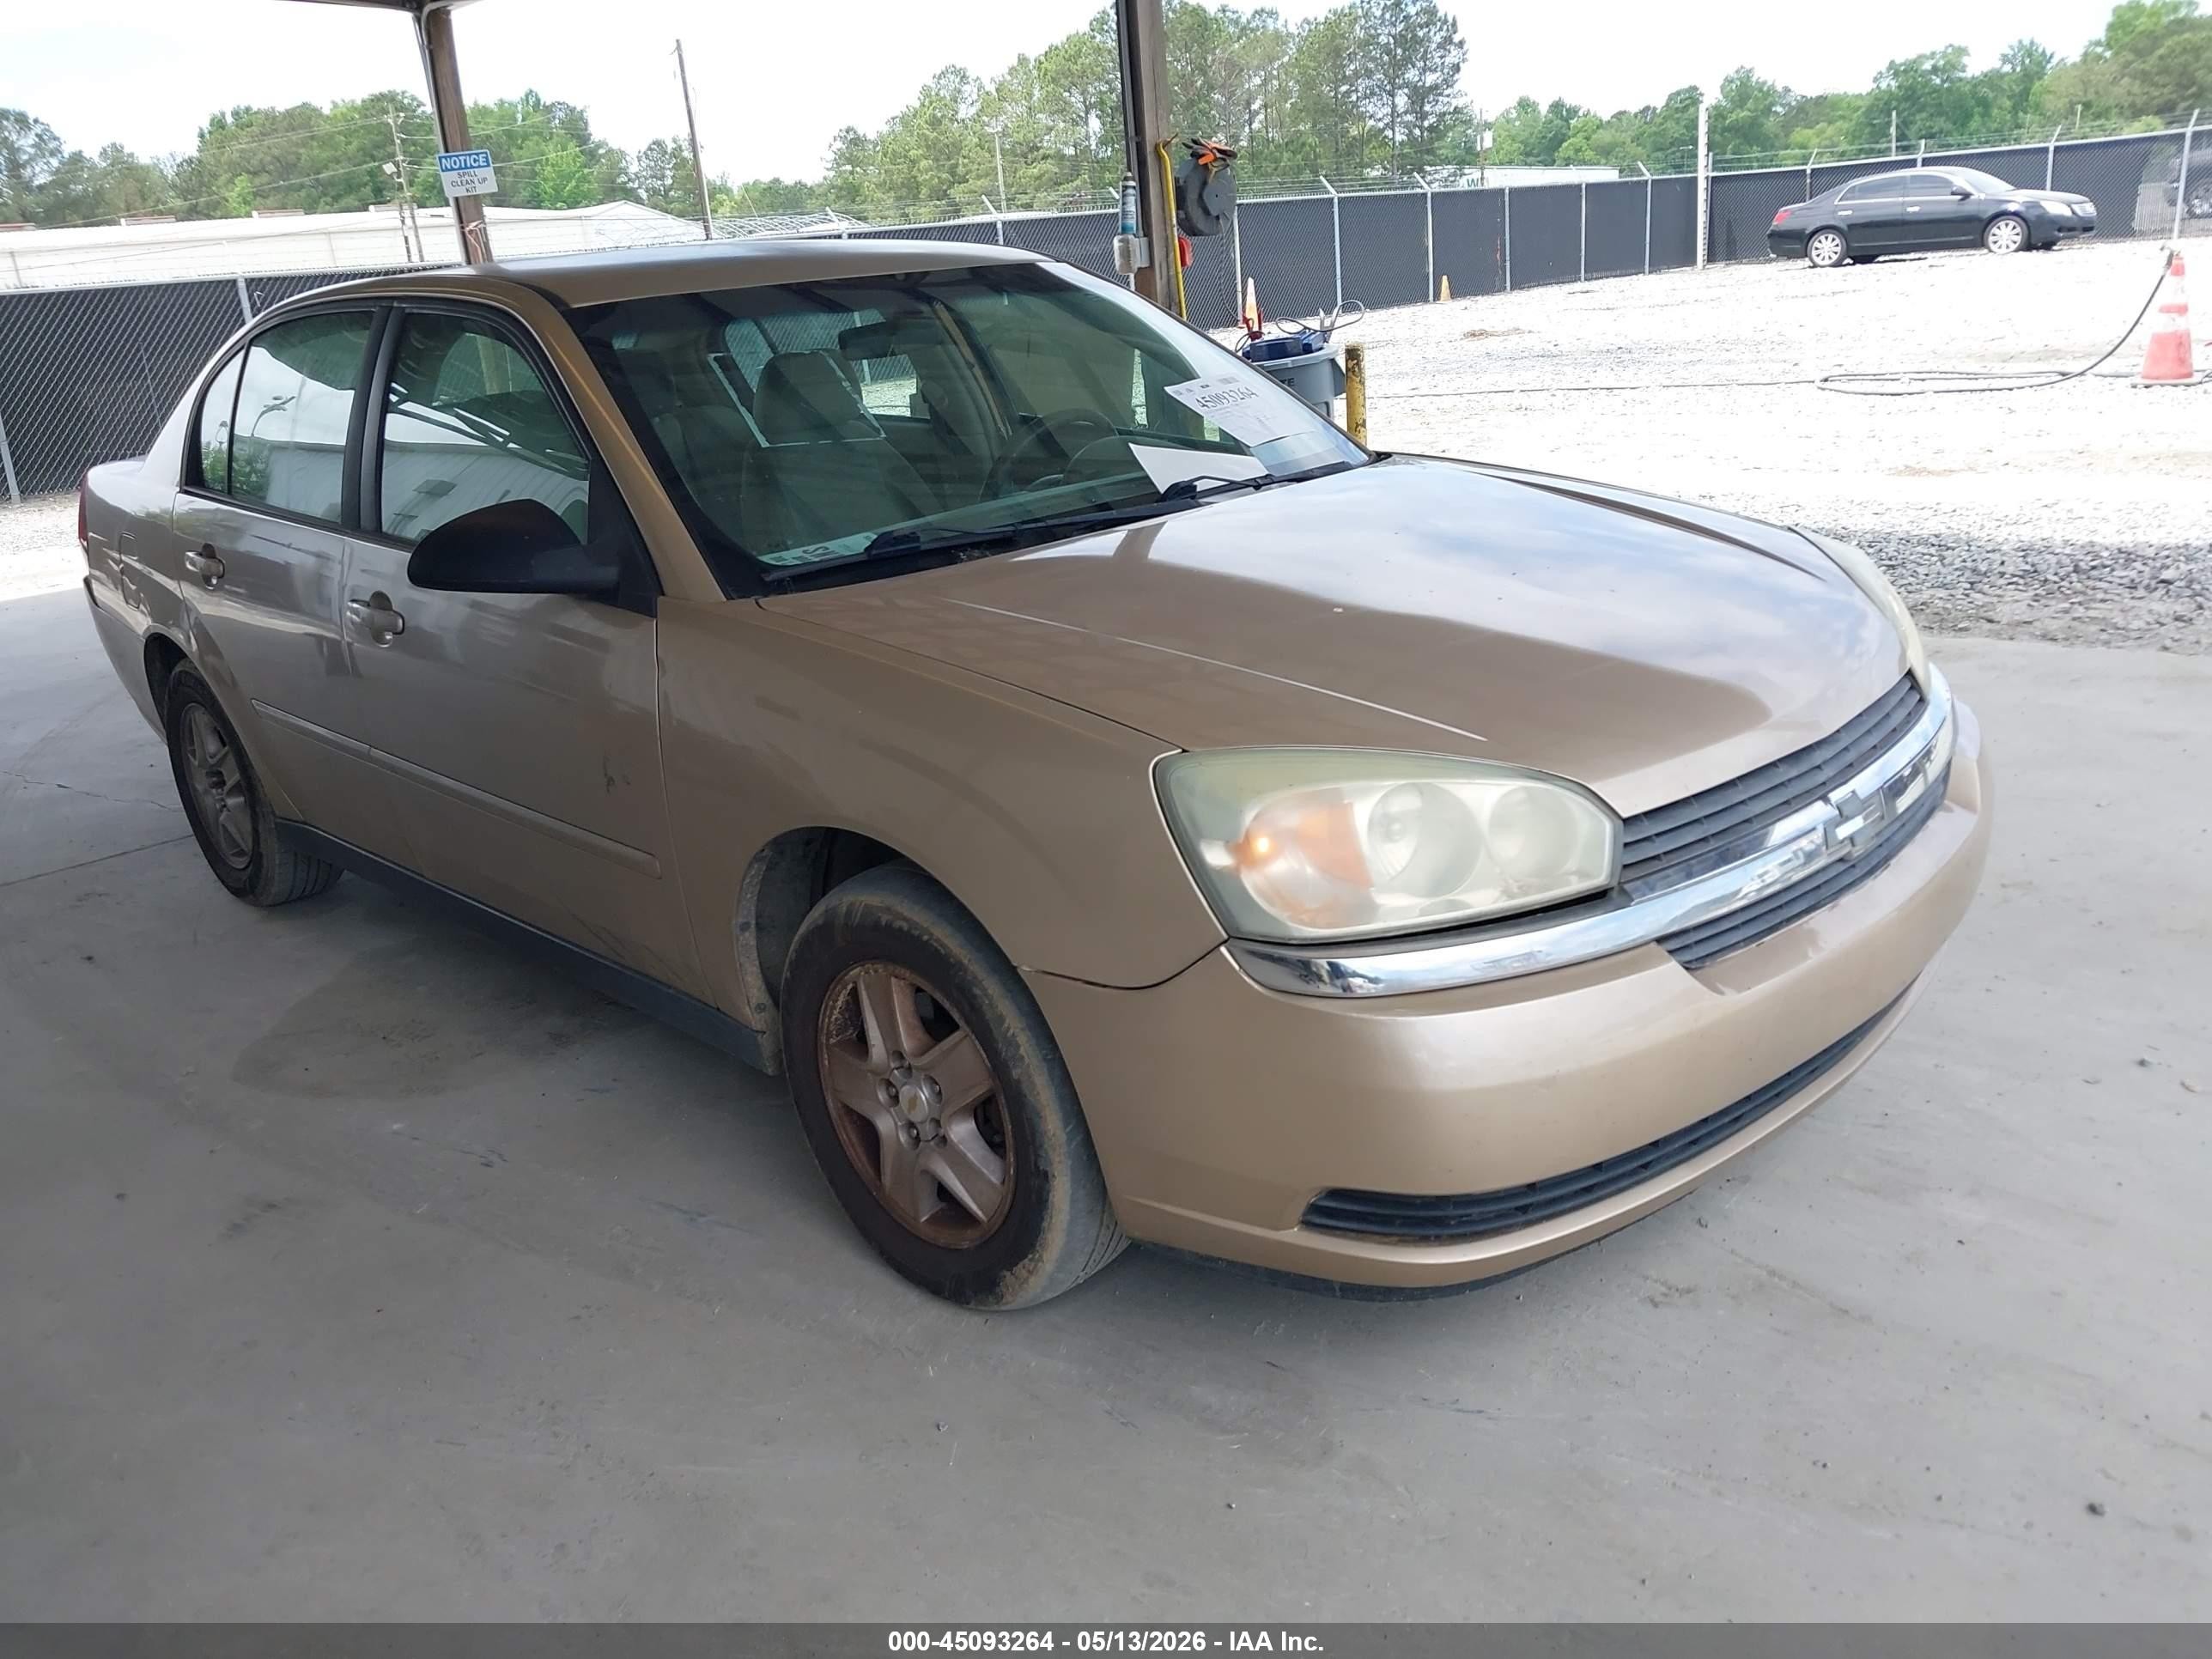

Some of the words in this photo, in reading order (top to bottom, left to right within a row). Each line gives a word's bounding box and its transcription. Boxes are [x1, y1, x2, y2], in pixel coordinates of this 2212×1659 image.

[441, 154, 487, 171] NOTICE
[457, 170, 478, 179] SPILL
[451, 178, 476, 187] CLEAN
[1195, 386, 1260, 410] 45093264
